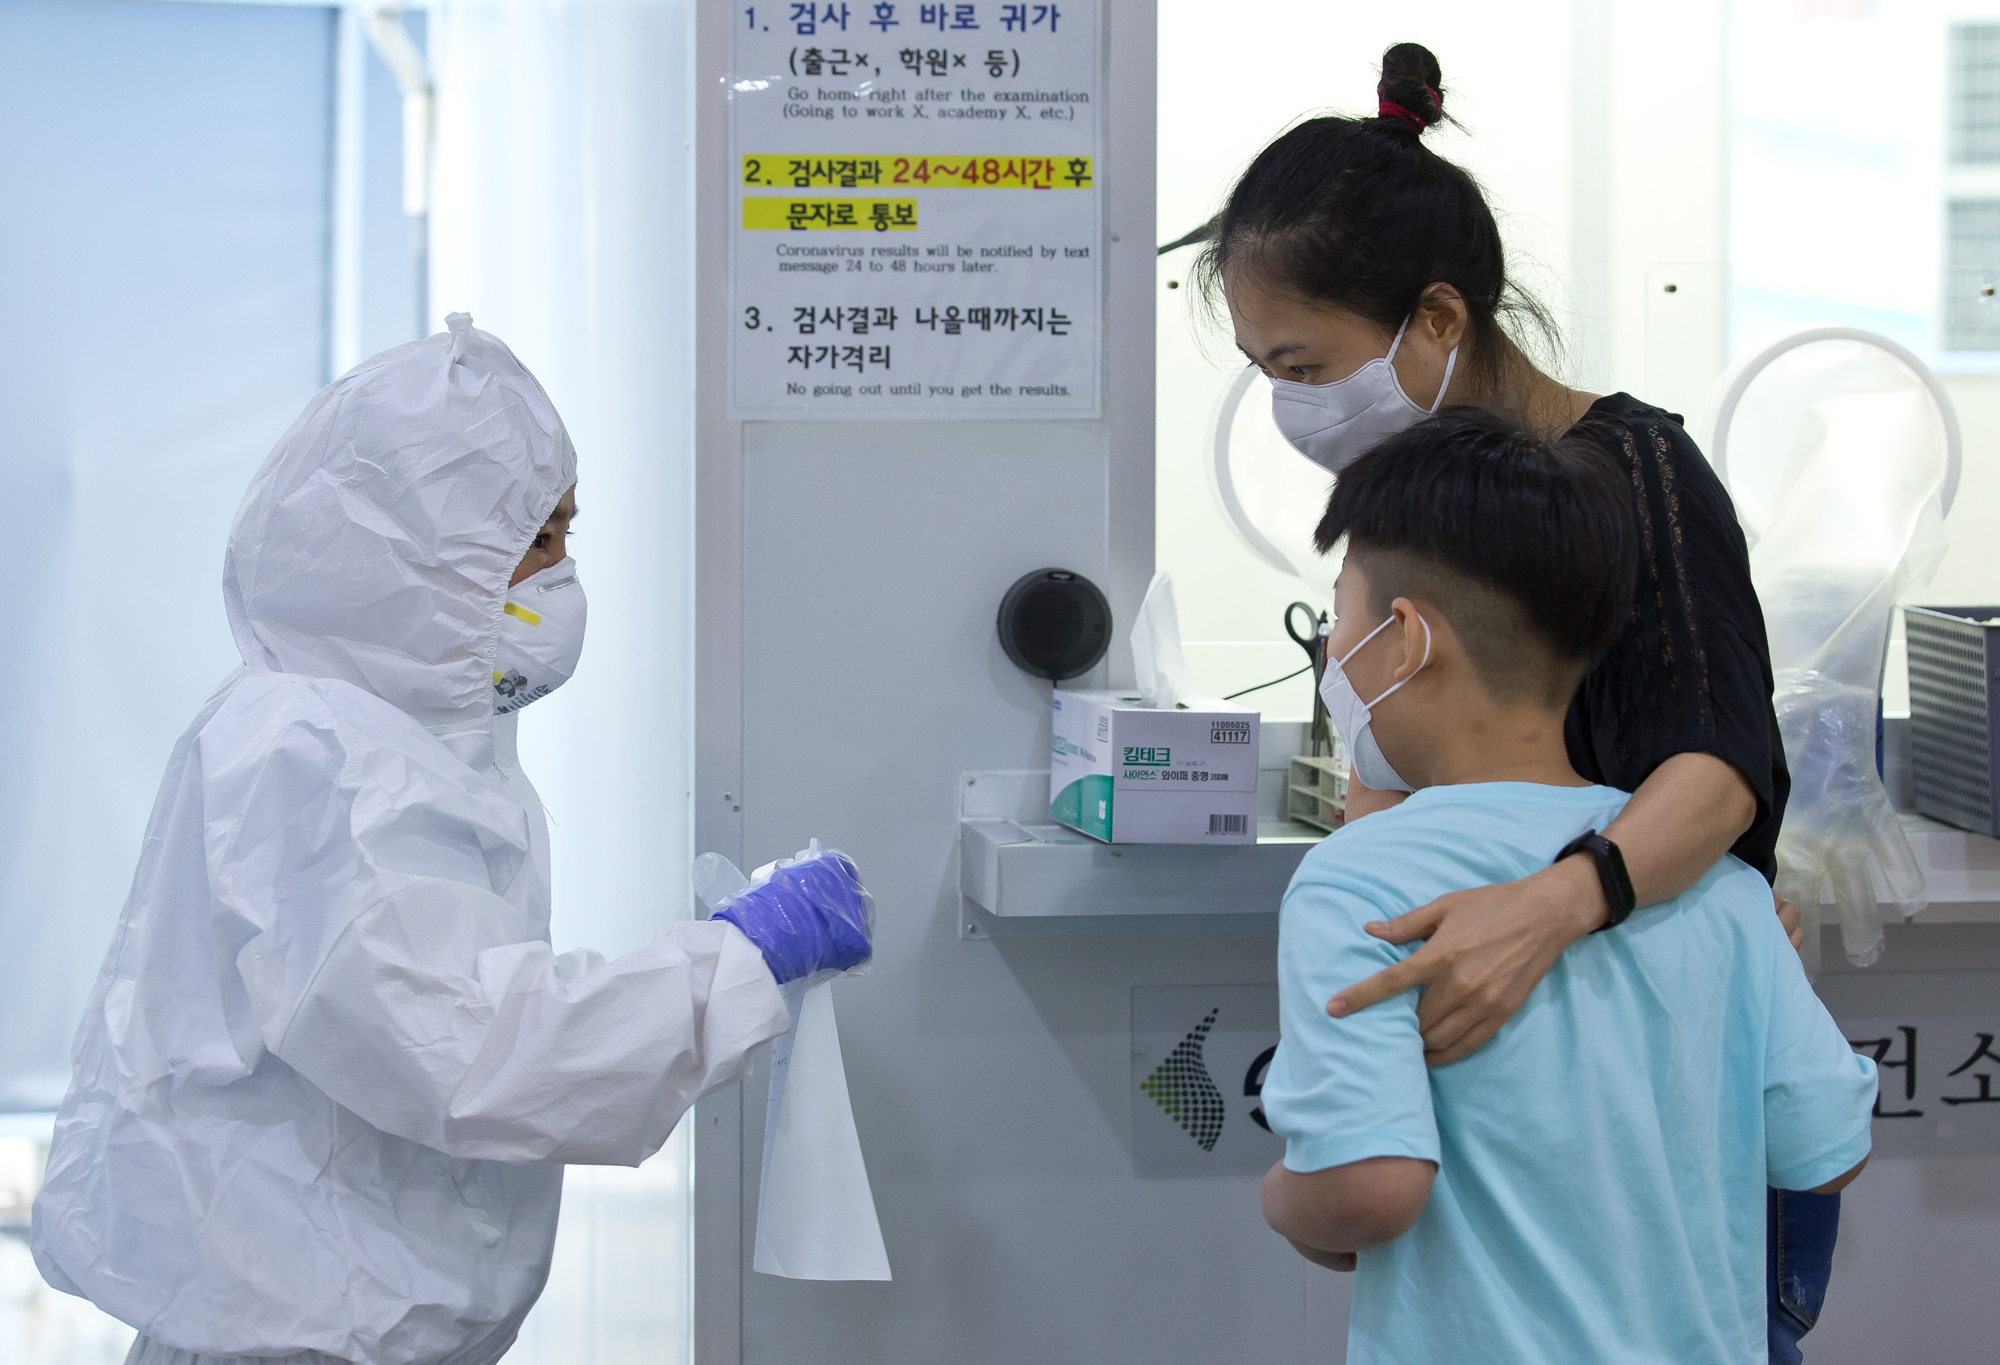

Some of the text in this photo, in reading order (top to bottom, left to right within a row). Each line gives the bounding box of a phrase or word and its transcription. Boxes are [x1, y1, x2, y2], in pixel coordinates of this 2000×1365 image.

[745, 1, 1060, 35] 1. 검사 후 바로 귀가
[984, 49, 1020, 77] 등)
[788, 87, 809, 101] Go
[868, 88, 906, 105] right
[915, 88, 953, 102] after
[961, 88, 985, 102] the
[994, 88, 1089, 102] examination
[783, 104, 833, 120] (Going
[842, 105, 858, 118] to
[867, 105, 904, 118] work
[938, 106, 1007, 121] academy
[1040, 105, 1075, 121] etc.)
[745, 160, 772, 185] 2.
[788, 160, 881, 188] 검사결과
[1064, 158, 1092, 186] 후
[786, 203, 916, 231] 문자로 통보
[777, 244, 1089, 259] Coronavirus results will be notified by text
[779, 260, 998, 274] message 24 to 48 hours later.
[745, 306, 1072, 335] 3. 검사결과 나올때까지는
[788, 345, 891, 372] 자가격리
[787, 383, 1070, 398] No going out until you get the results.
[1214, 731, 1247, 741] 41117
[1124, 747, 1170, 762] 킴테크
[1123, 770, 1157, 780] 사이언스
[1162, 771, 1188, 780] 와이퍼
[1191, 771, 1208, 781] 중형
